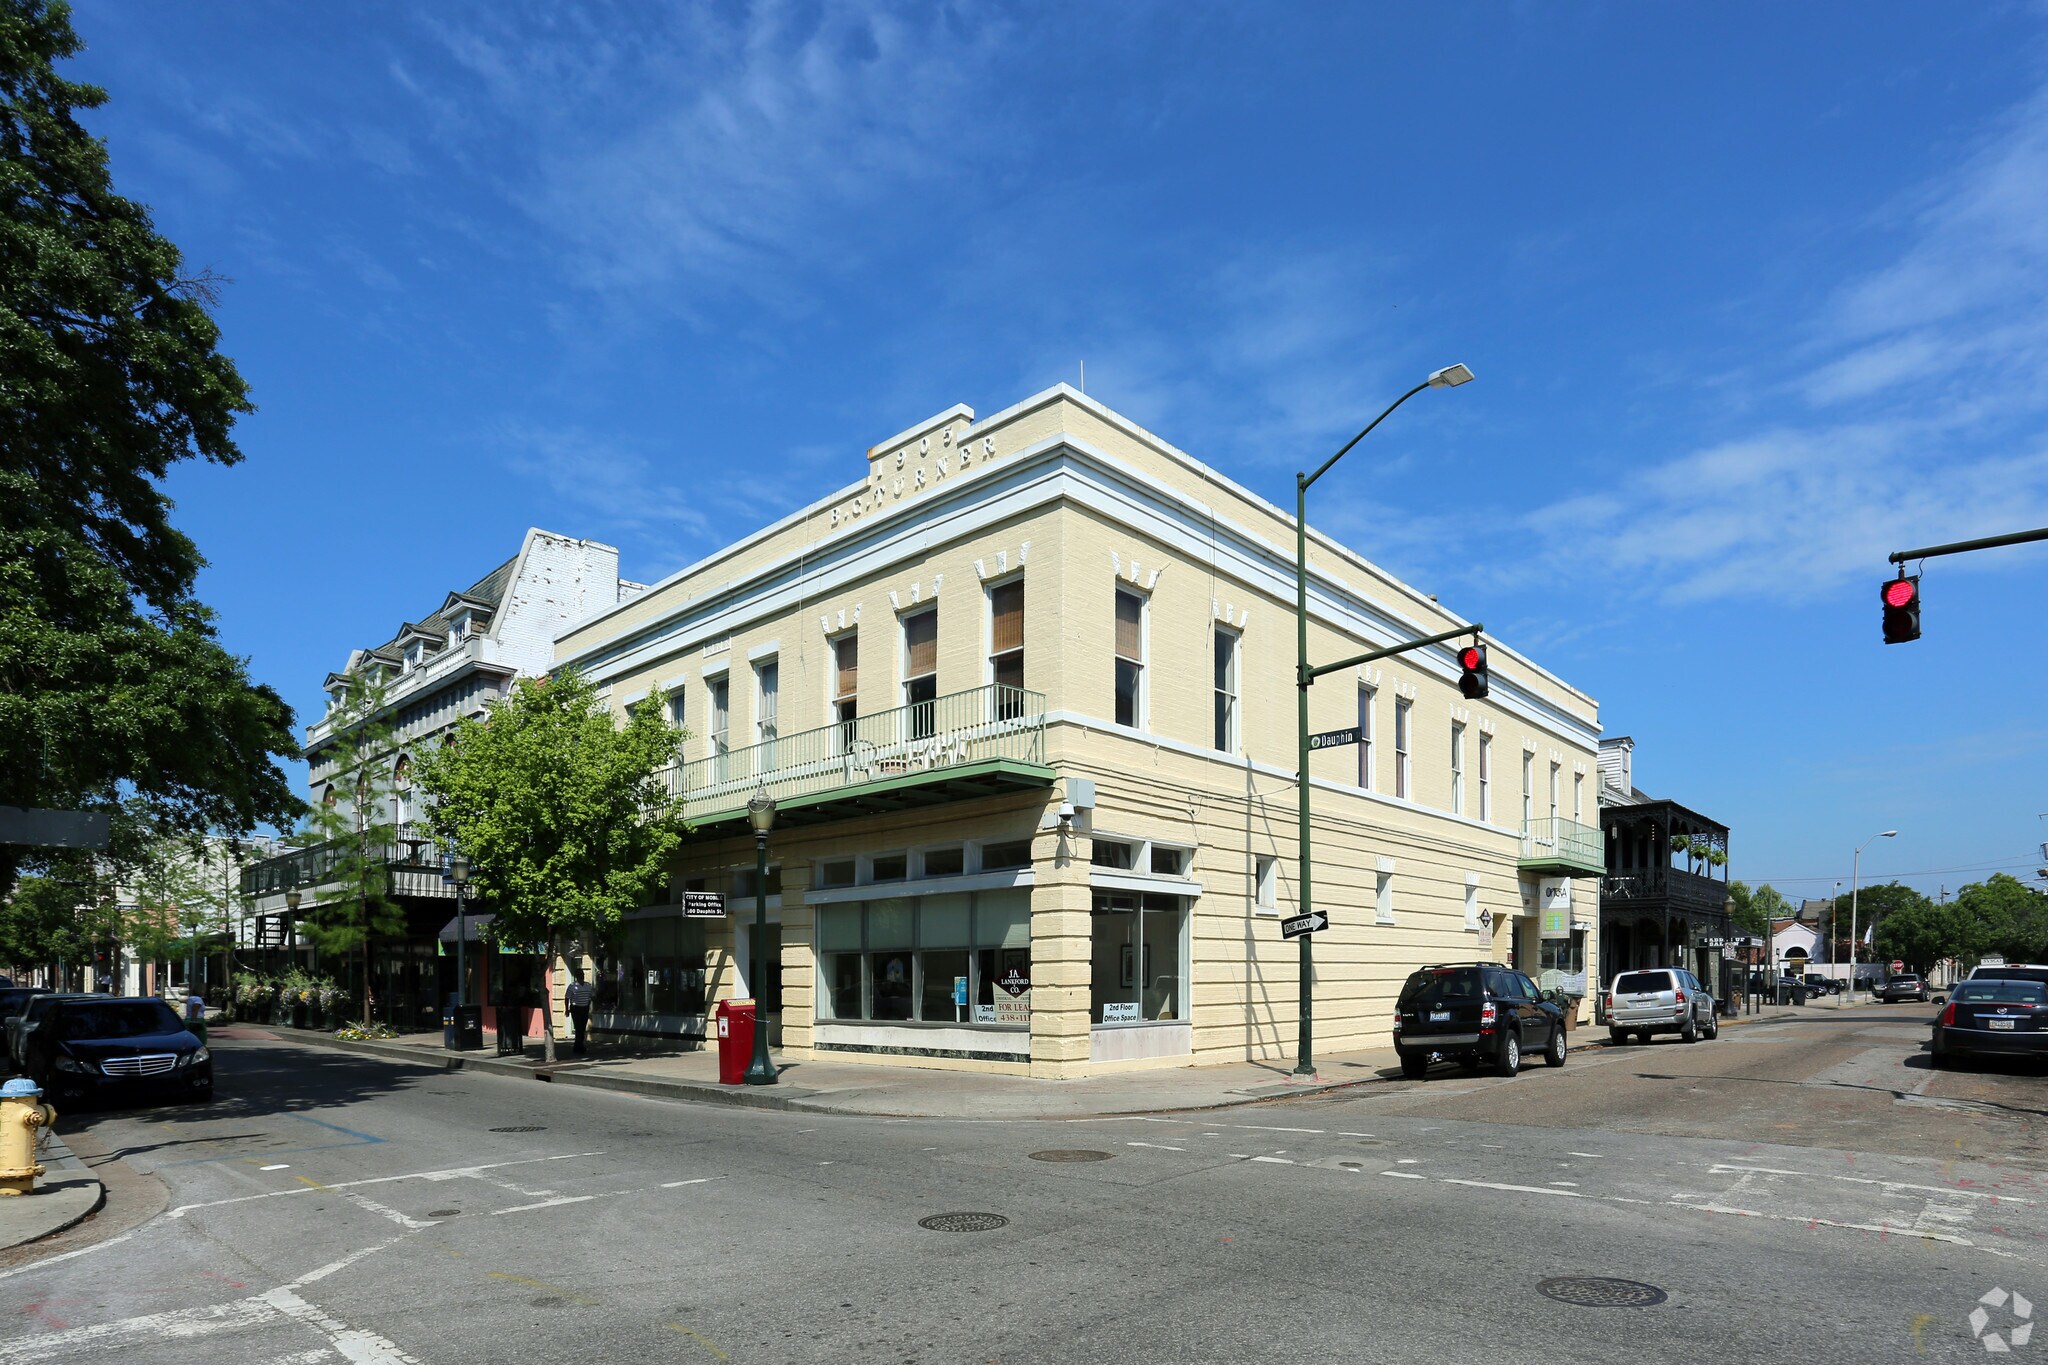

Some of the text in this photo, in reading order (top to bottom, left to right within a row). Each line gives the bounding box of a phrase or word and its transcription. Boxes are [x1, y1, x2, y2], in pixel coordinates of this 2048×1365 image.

[876, 426, 953, 477] 1905
[1321, 731, 1353, 747] Dauphin
[1285, 920, 1310, 933] ONE WAY
[998, 1003, 1012, 1011] FOR
[1121, 1014, 1136, 1022] Space
